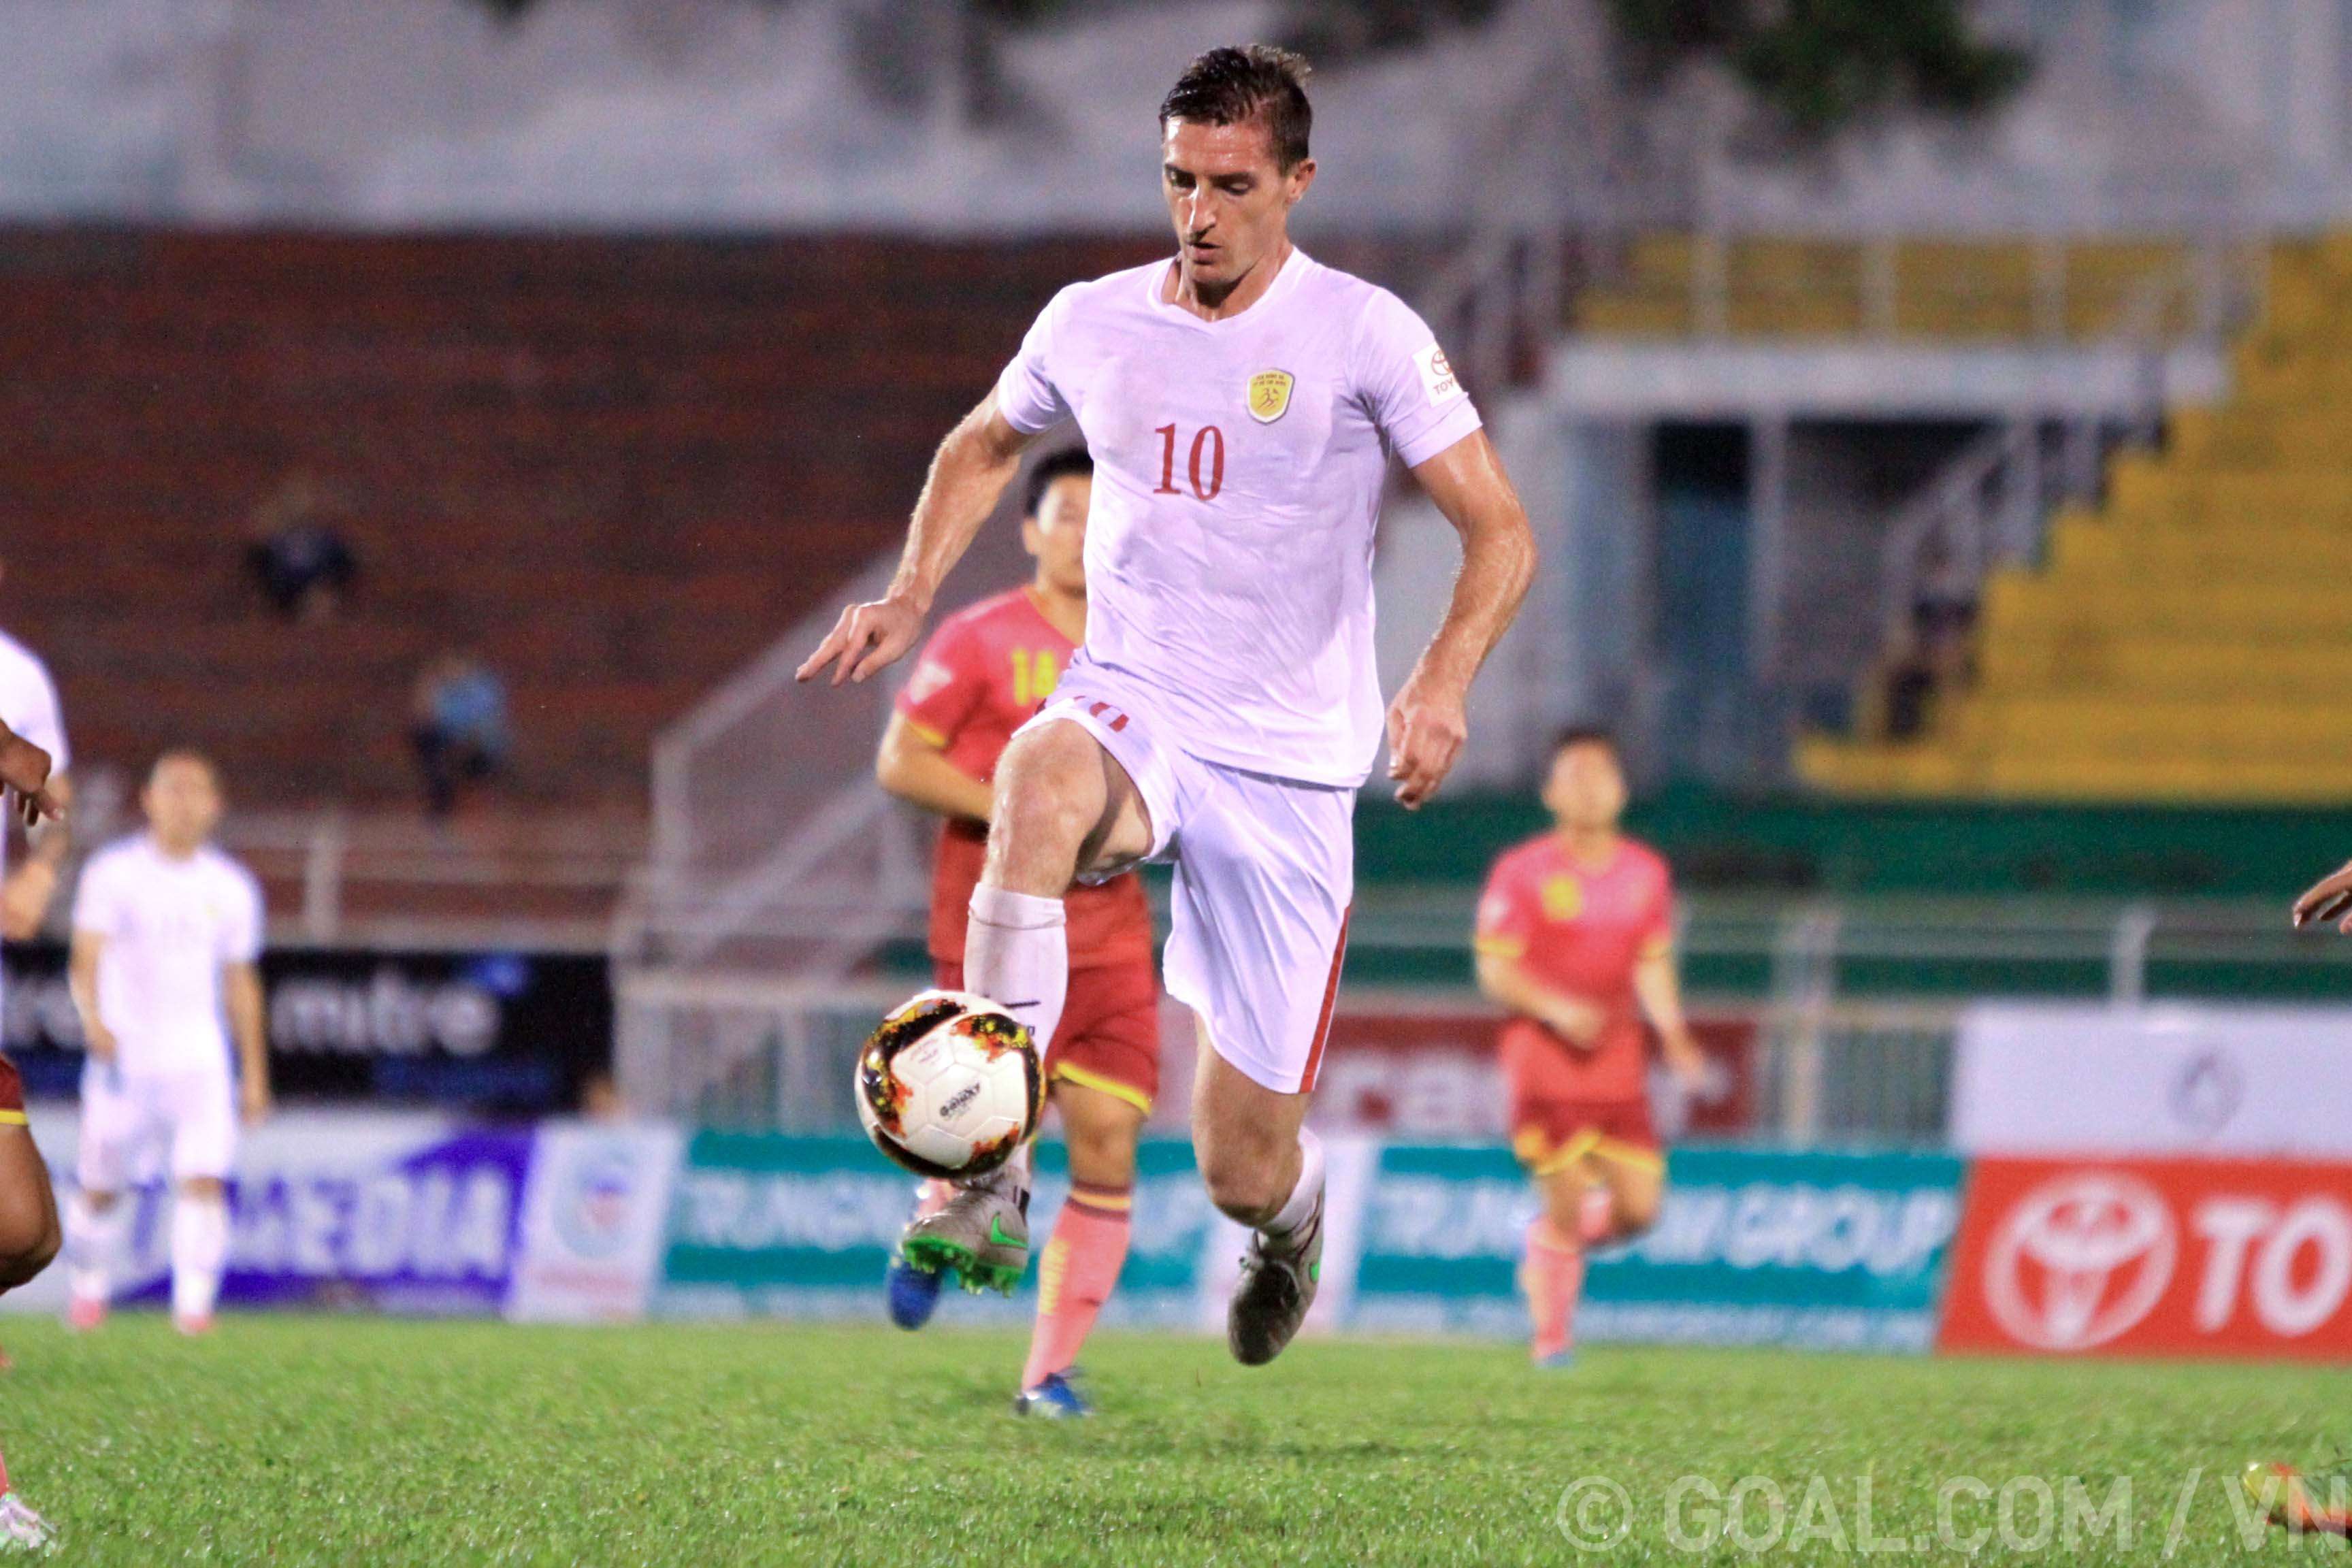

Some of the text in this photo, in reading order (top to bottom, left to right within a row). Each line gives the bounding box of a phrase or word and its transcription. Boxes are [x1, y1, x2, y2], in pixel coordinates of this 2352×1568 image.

[1153, 423, 1224, 501] 10
[272, 966, 500, 1056] mitre
[1726, 1182, 1955, 1275] GROUP
[2193, 1192, 2352, 1338] TO
